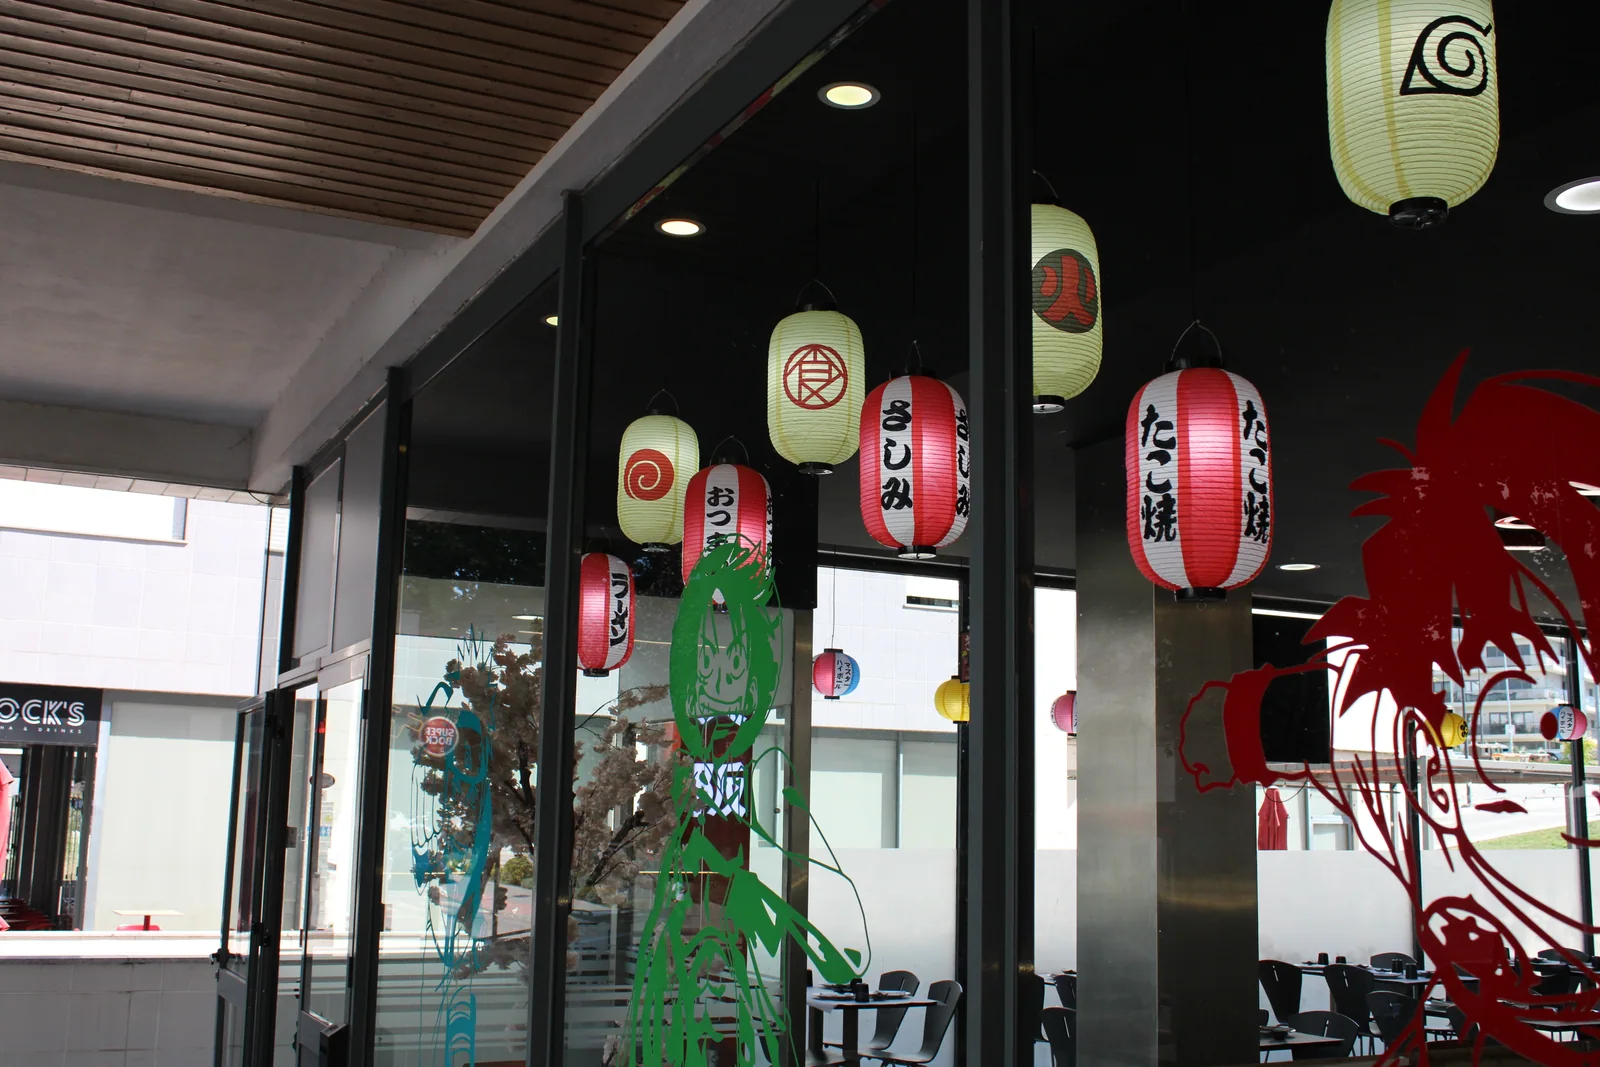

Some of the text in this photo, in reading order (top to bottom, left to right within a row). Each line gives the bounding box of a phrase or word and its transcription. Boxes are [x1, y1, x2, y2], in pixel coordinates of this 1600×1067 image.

[706, 486, 735, 558] おつま
[1141, 403, 1177, 543] たこ焼
[1242, 400, 1270, 544] たこ焼
[610, 572, 629, 647] ラーメン
